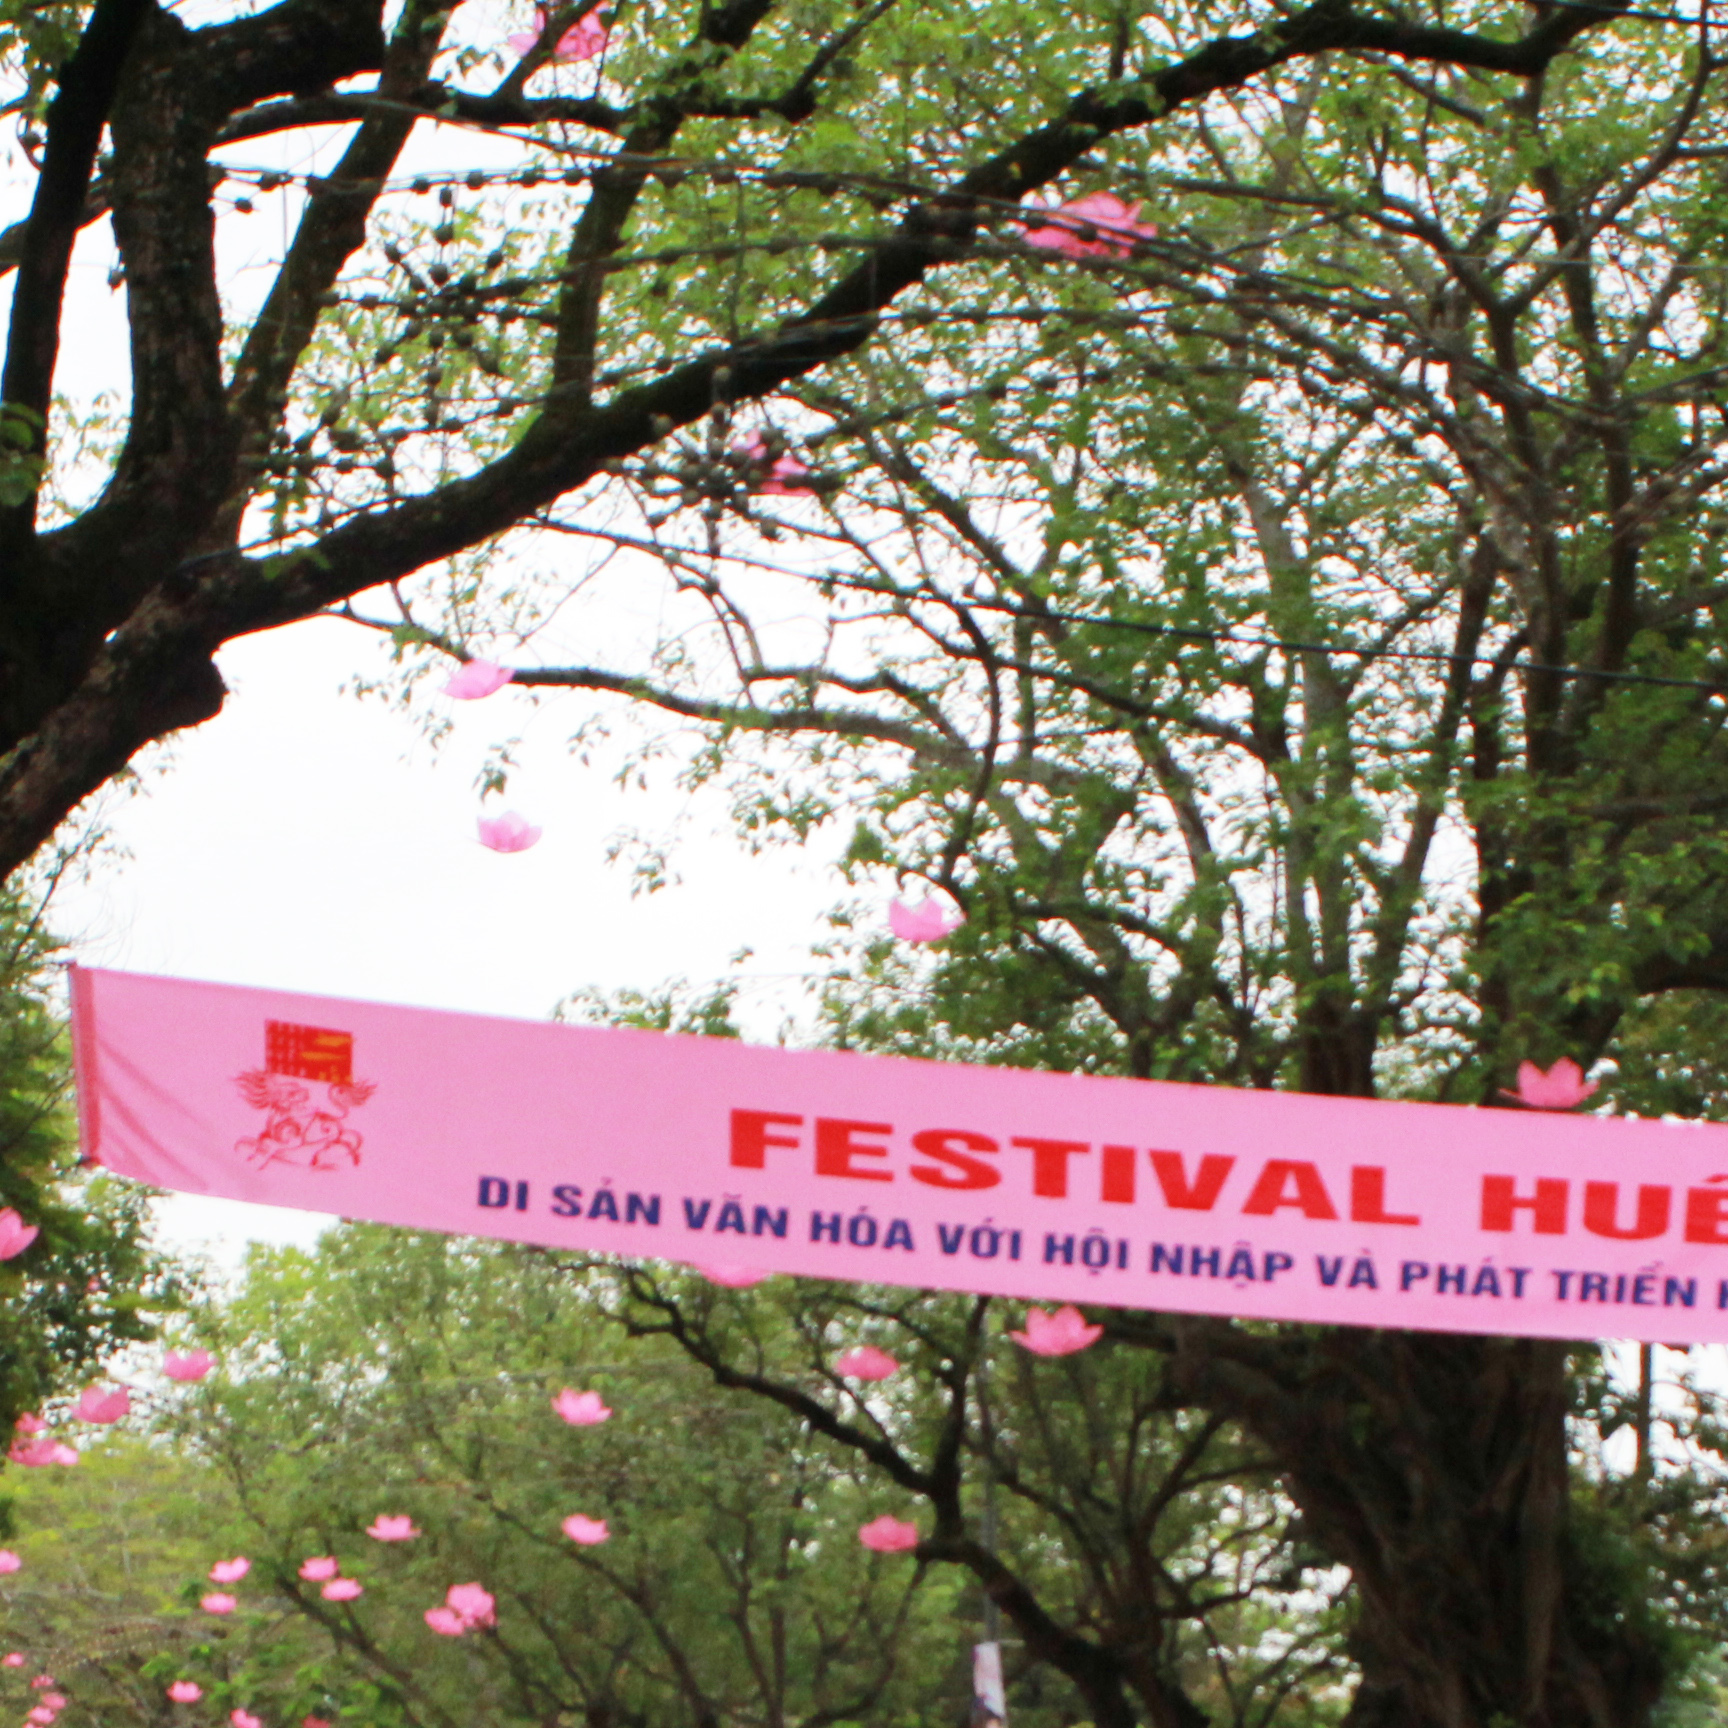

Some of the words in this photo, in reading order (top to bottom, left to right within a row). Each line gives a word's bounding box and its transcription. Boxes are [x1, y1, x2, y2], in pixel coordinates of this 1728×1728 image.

[729, 1107, 1422, 1226] FESTIVAL
[477, 1175, 529, 1212] DI
[551, 1177, 661, 1226] SẢN
[683, 1192, 788, 1239] VĂN
[810, 1206, 915, 1252] HÓA
[938, 1219, 1021, 1262] VỚI
[1043, 1228, 1129, 1275] HỘI
[1148, 1240, 1294, 1288] NHẬP
[1316, 1249, 1380, 1290] VÀ
[1399, 1257, 1532, 1299] PHÁT
